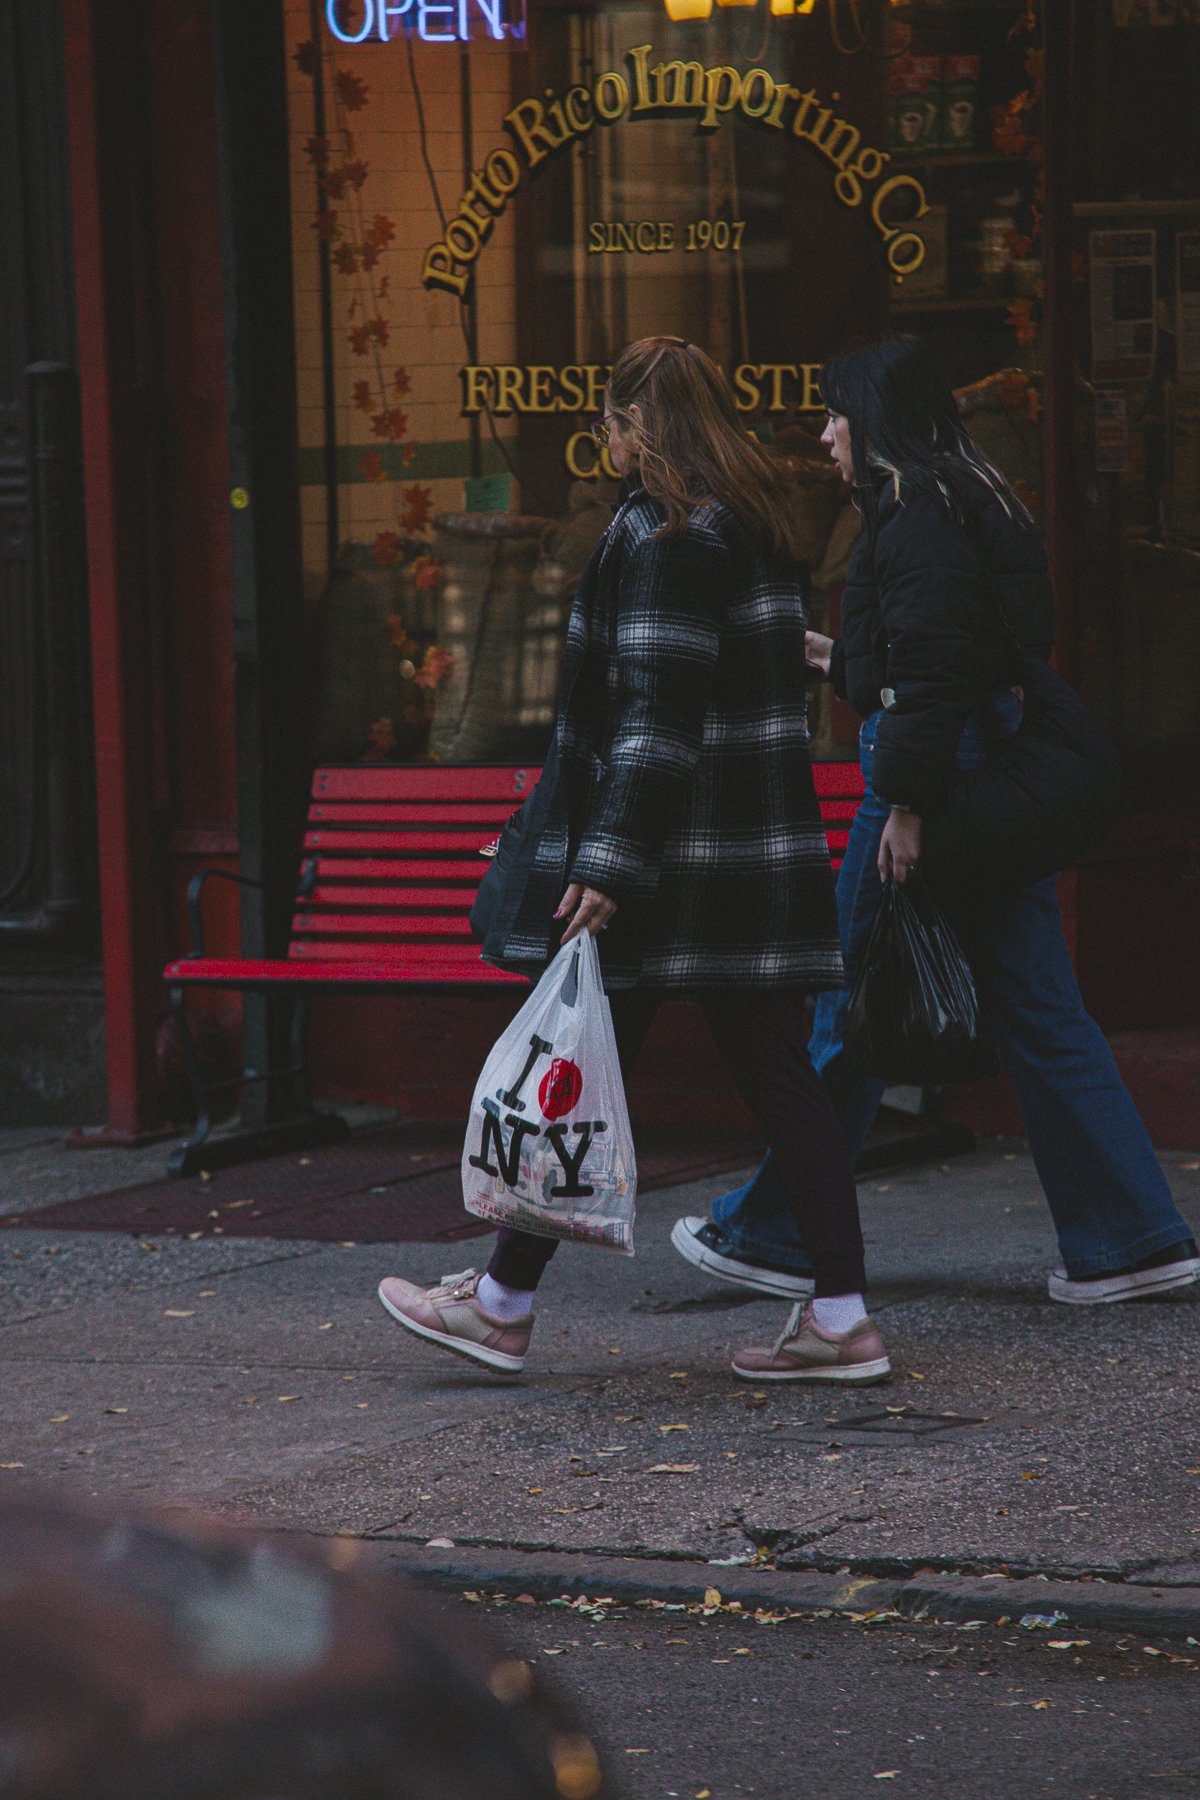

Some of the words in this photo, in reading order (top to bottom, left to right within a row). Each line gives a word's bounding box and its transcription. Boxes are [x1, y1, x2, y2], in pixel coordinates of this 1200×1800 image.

[325, 0, 505, 42] OPEN
[421, 149, 521, 297] Porto
[504, 71, 629, 168] Rico
[628, 44, 891, 208] Importing
[589, 222, 674, 252] SINCE
[686, 220, 746, 251] 1907
[496, 1034, 553, 1112] I
[468, 1096, 609, 1198] NY
